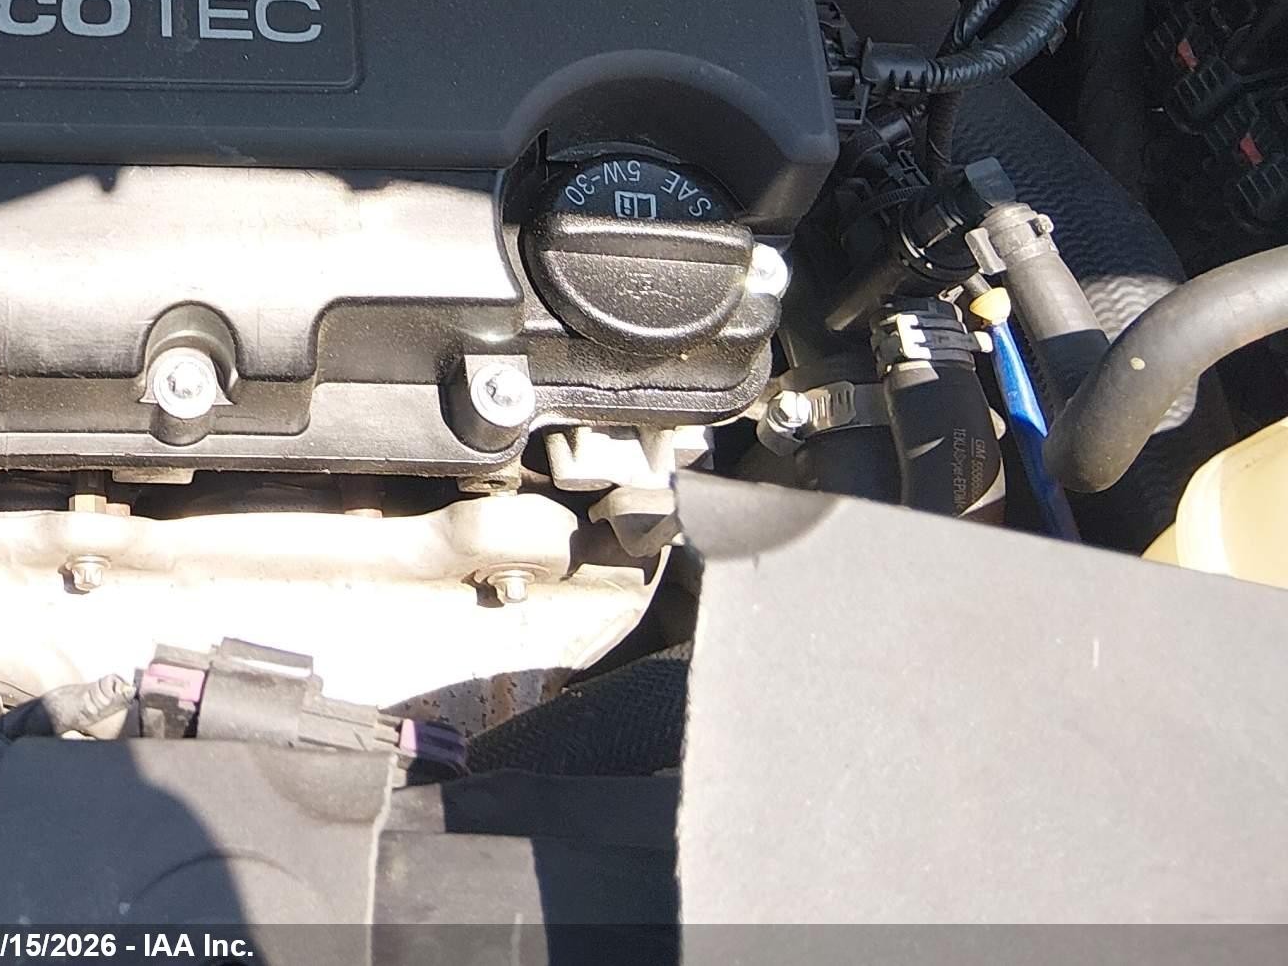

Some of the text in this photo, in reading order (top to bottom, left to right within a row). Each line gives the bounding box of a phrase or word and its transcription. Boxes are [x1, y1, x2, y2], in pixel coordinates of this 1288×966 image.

[565, 160, 712, 217] SAE 5W-30
[972, 438, 987, 459] GM
